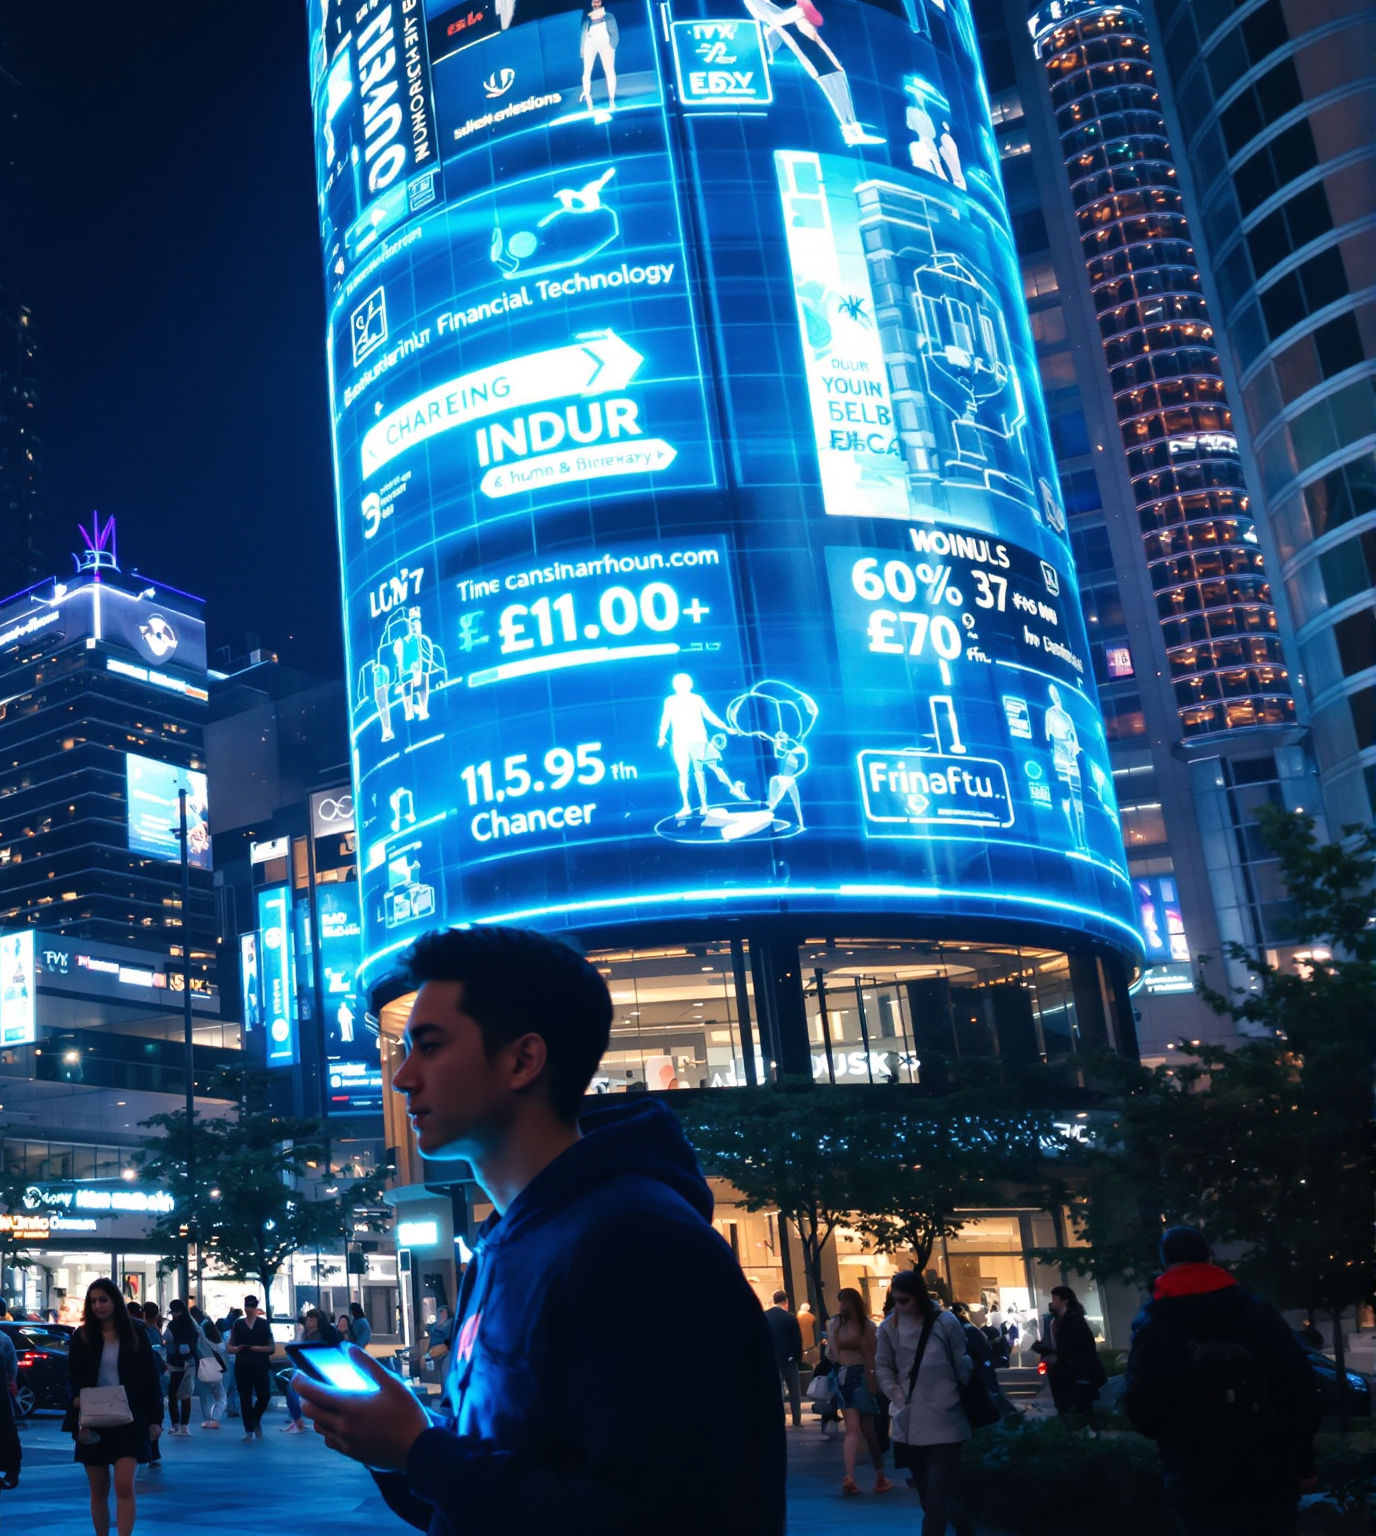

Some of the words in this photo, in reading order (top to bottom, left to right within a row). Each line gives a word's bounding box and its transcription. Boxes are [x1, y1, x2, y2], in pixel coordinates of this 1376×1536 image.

[437, 287, 533, 337] Financial
[536, 263, 674, 301] Technology
[386, 376, 511, 445] CHAREING
[476, 398, 642, 468] INDUR
[851, 557, 964, 607] 60%
[971, 569, 1008, 613] 37
[470, 802, 597, 842] Chancer
